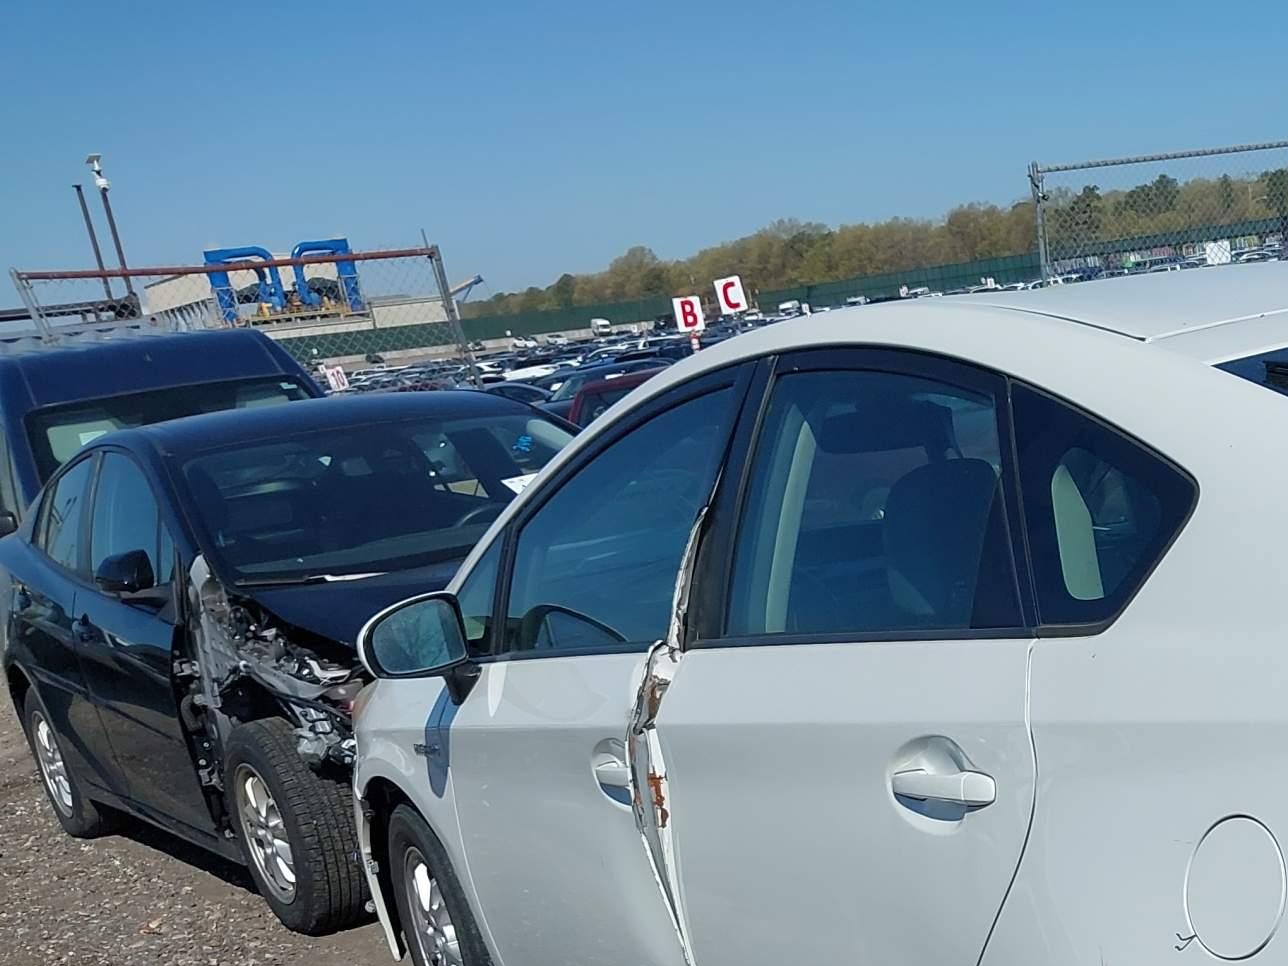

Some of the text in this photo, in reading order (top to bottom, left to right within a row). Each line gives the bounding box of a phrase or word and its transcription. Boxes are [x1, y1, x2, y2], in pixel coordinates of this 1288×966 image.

[722, 281, 741, 309] C
[680, 299, 698, 328] B
[331, 369, 346, 389] 10
